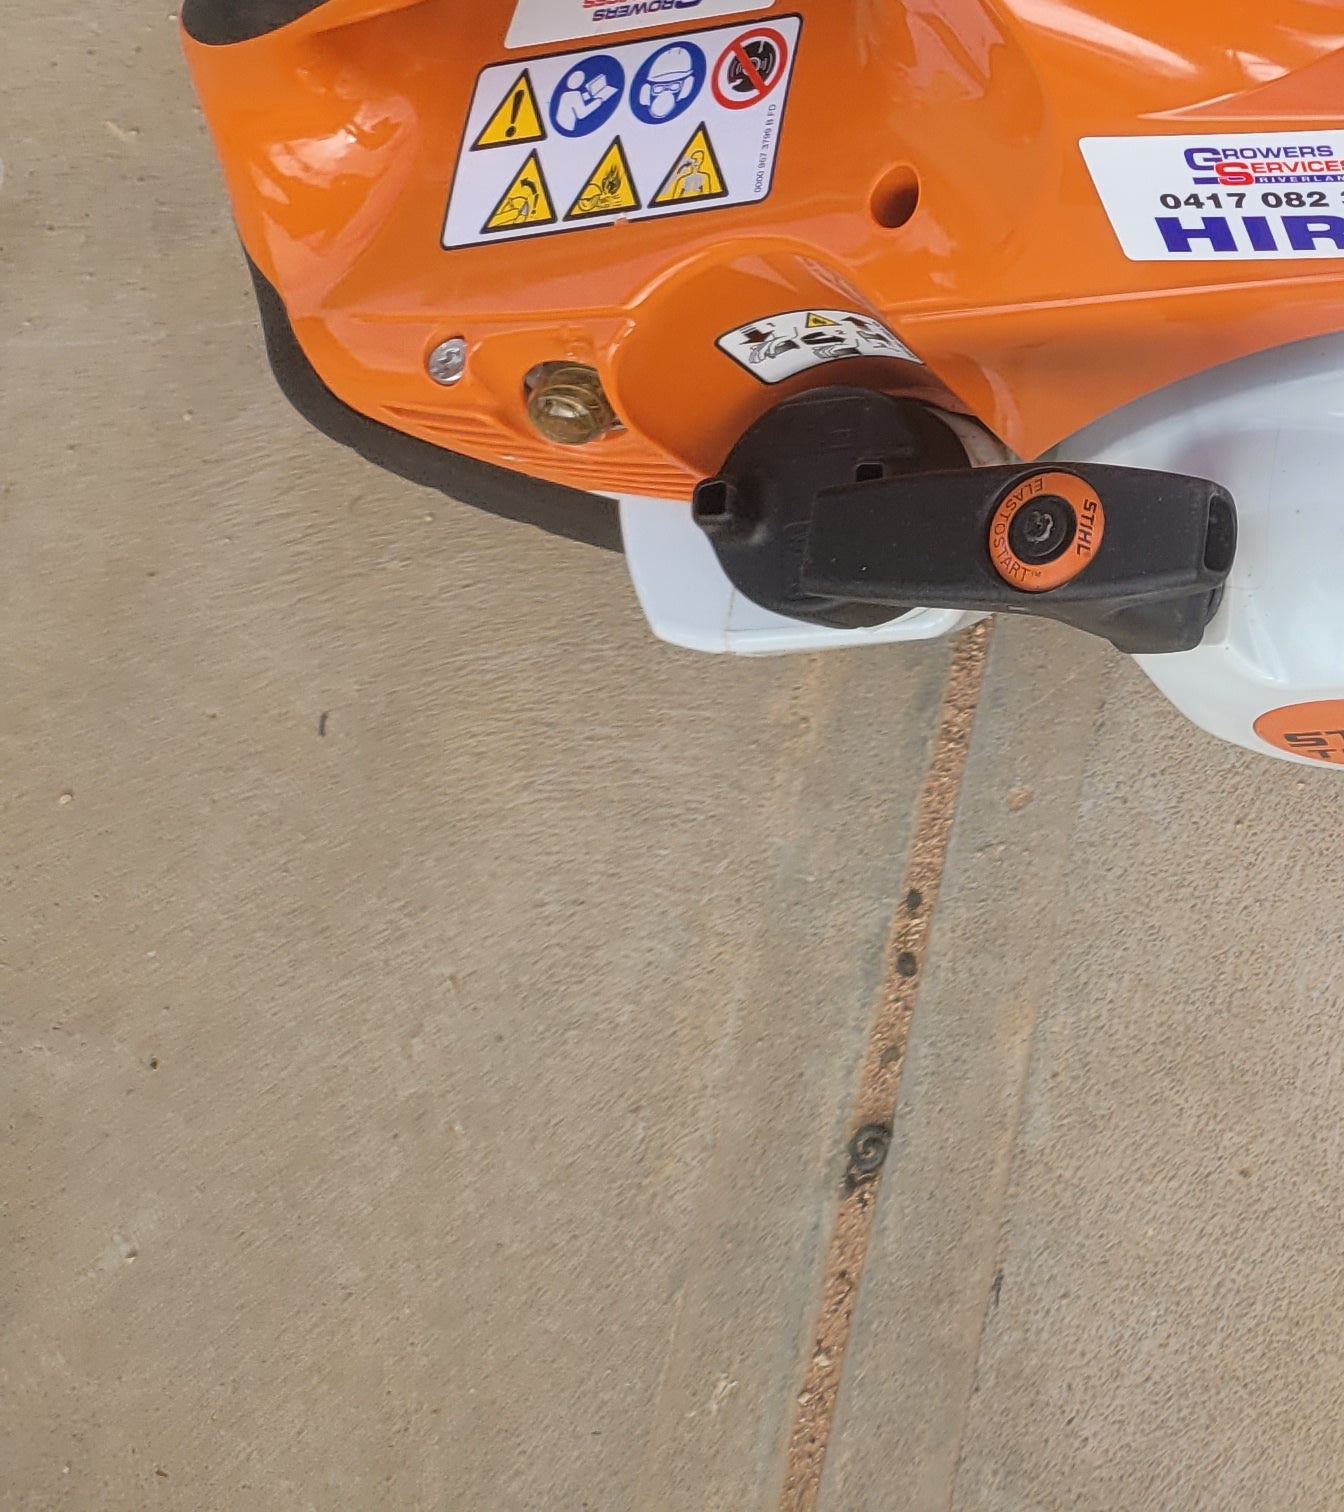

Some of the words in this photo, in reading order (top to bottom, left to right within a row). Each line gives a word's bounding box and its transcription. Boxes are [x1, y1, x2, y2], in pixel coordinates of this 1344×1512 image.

[1183, 145, 1334, 171] GROWERS
[1159, 192, 1247, 210] 0417
[1261, 190, 1330, 209] 082
[1076, 498, 1098, 556] STIHL
